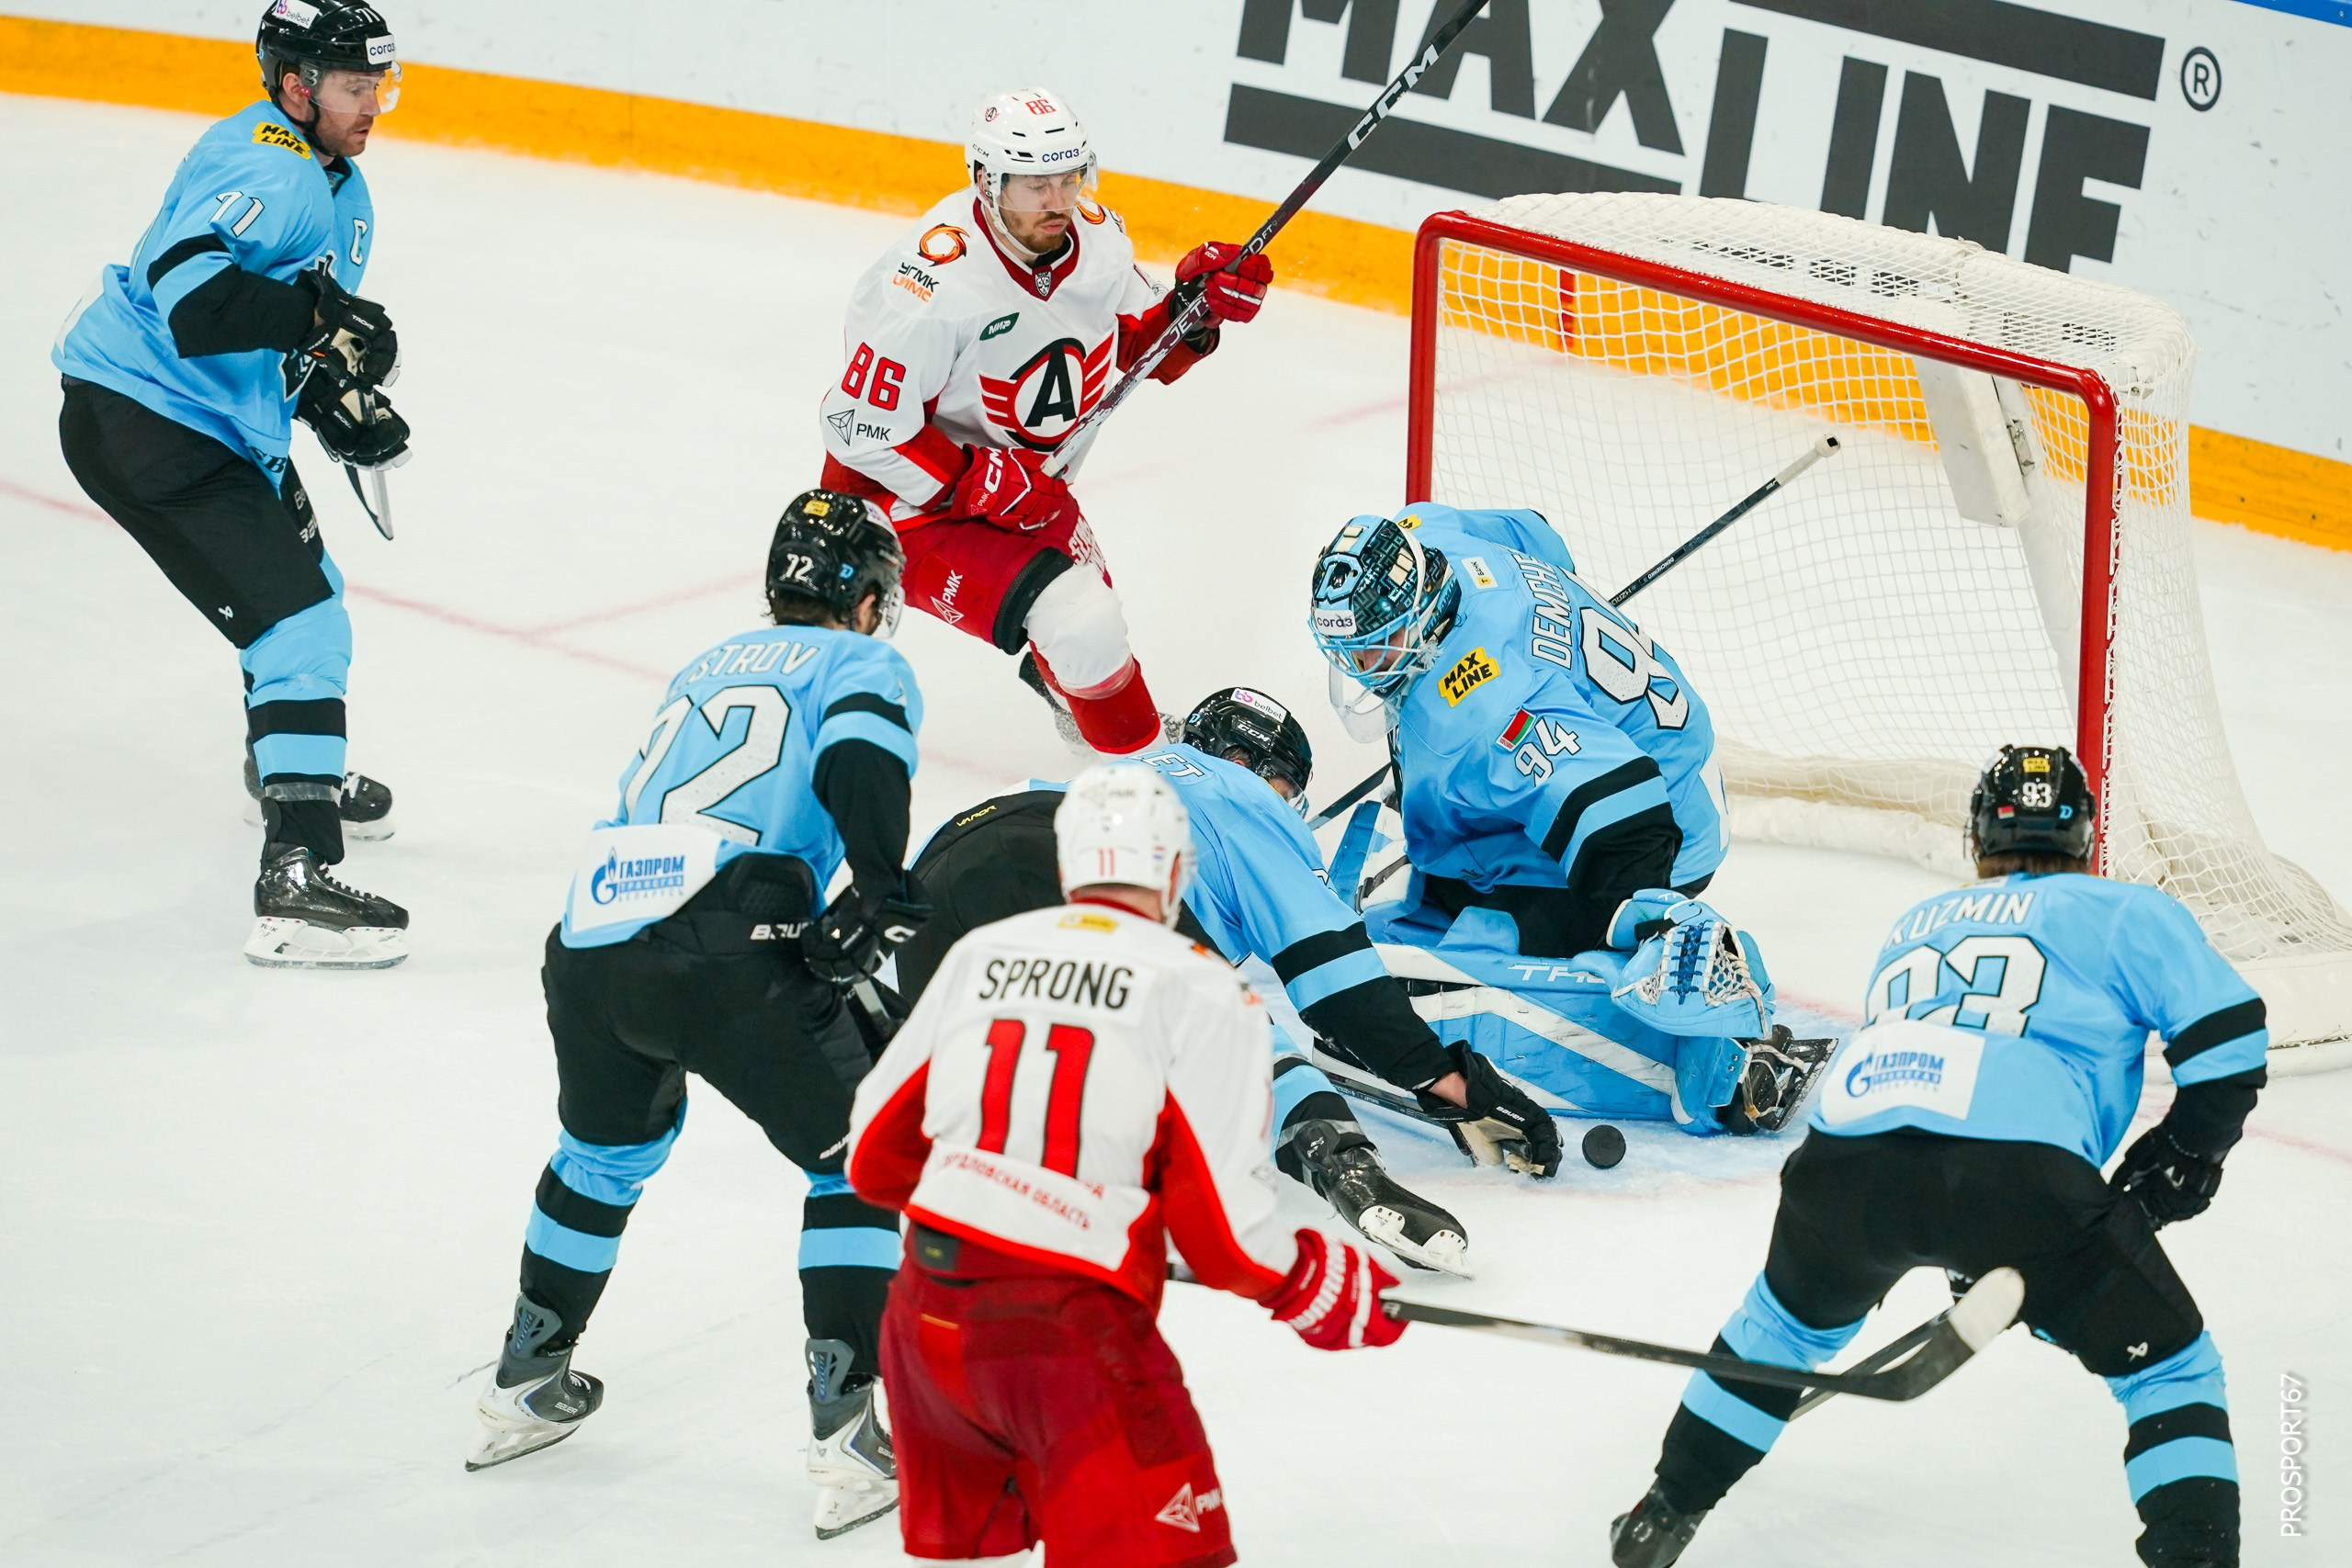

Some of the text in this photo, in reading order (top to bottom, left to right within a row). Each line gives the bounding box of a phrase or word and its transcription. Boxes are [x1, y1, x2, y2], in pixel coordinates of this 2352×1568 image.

[286, 9, 311, 26] belbet
[355, 7, 380, 23] 71
[1025, 98, 1057, 115] 86
[1348, 43, 1439, 150] CCM
[262, 124, 304, 144] MAX
[262, 135, 305, 154] LINE
[972, 143, 989, 158] CCM
[1042, 147, 1080, 163] согаз
[209, 190, 266, 238] 71
[350, 217, 368, 266] C
[897, 262, 940, 293] УГМК
[352, 314, 375, 330] TACKS
[988, 319, 1012, 335] МИР
[841, 342, 907, 412] 86
[784, 553, 814, 581] 72
[1317, 615, 1353, 627] согаз
[677, 640, 820, 689] STROV
[1443, 651, 1481, 690] MAX
[1452, 662, 1493, 700] LINE
[1254, 700, 1283, 720] belbet
[1238, 724, 1270, 742] CCM
[1134, 751, 1204, 777] ET
[1513, 716, 1582, 788] 94
[623, 684, 793, 847] 72
[2022, 782, 2052, 807] 93
[956, 804, 997, 826] VAPOR
[619, 855, 684, 879] ГАЗПРОМ
[1098, 848, 1115, 876] 11
[1882, 891, 2036, 951] KUZMIN
[978, 959, 1134, 1010] SPRONG
[1864, 935, 2047, 1038] 93
[1874, 1052, 1945, 1071] ГАЗПРОМ
[977, 1018, 1095, 1179] 11
[1496, 1105, 1526, 1122] BAUER
[820, 1133, 850, 1159] BAU
[554, 1402, 579, 1415] BAUER
